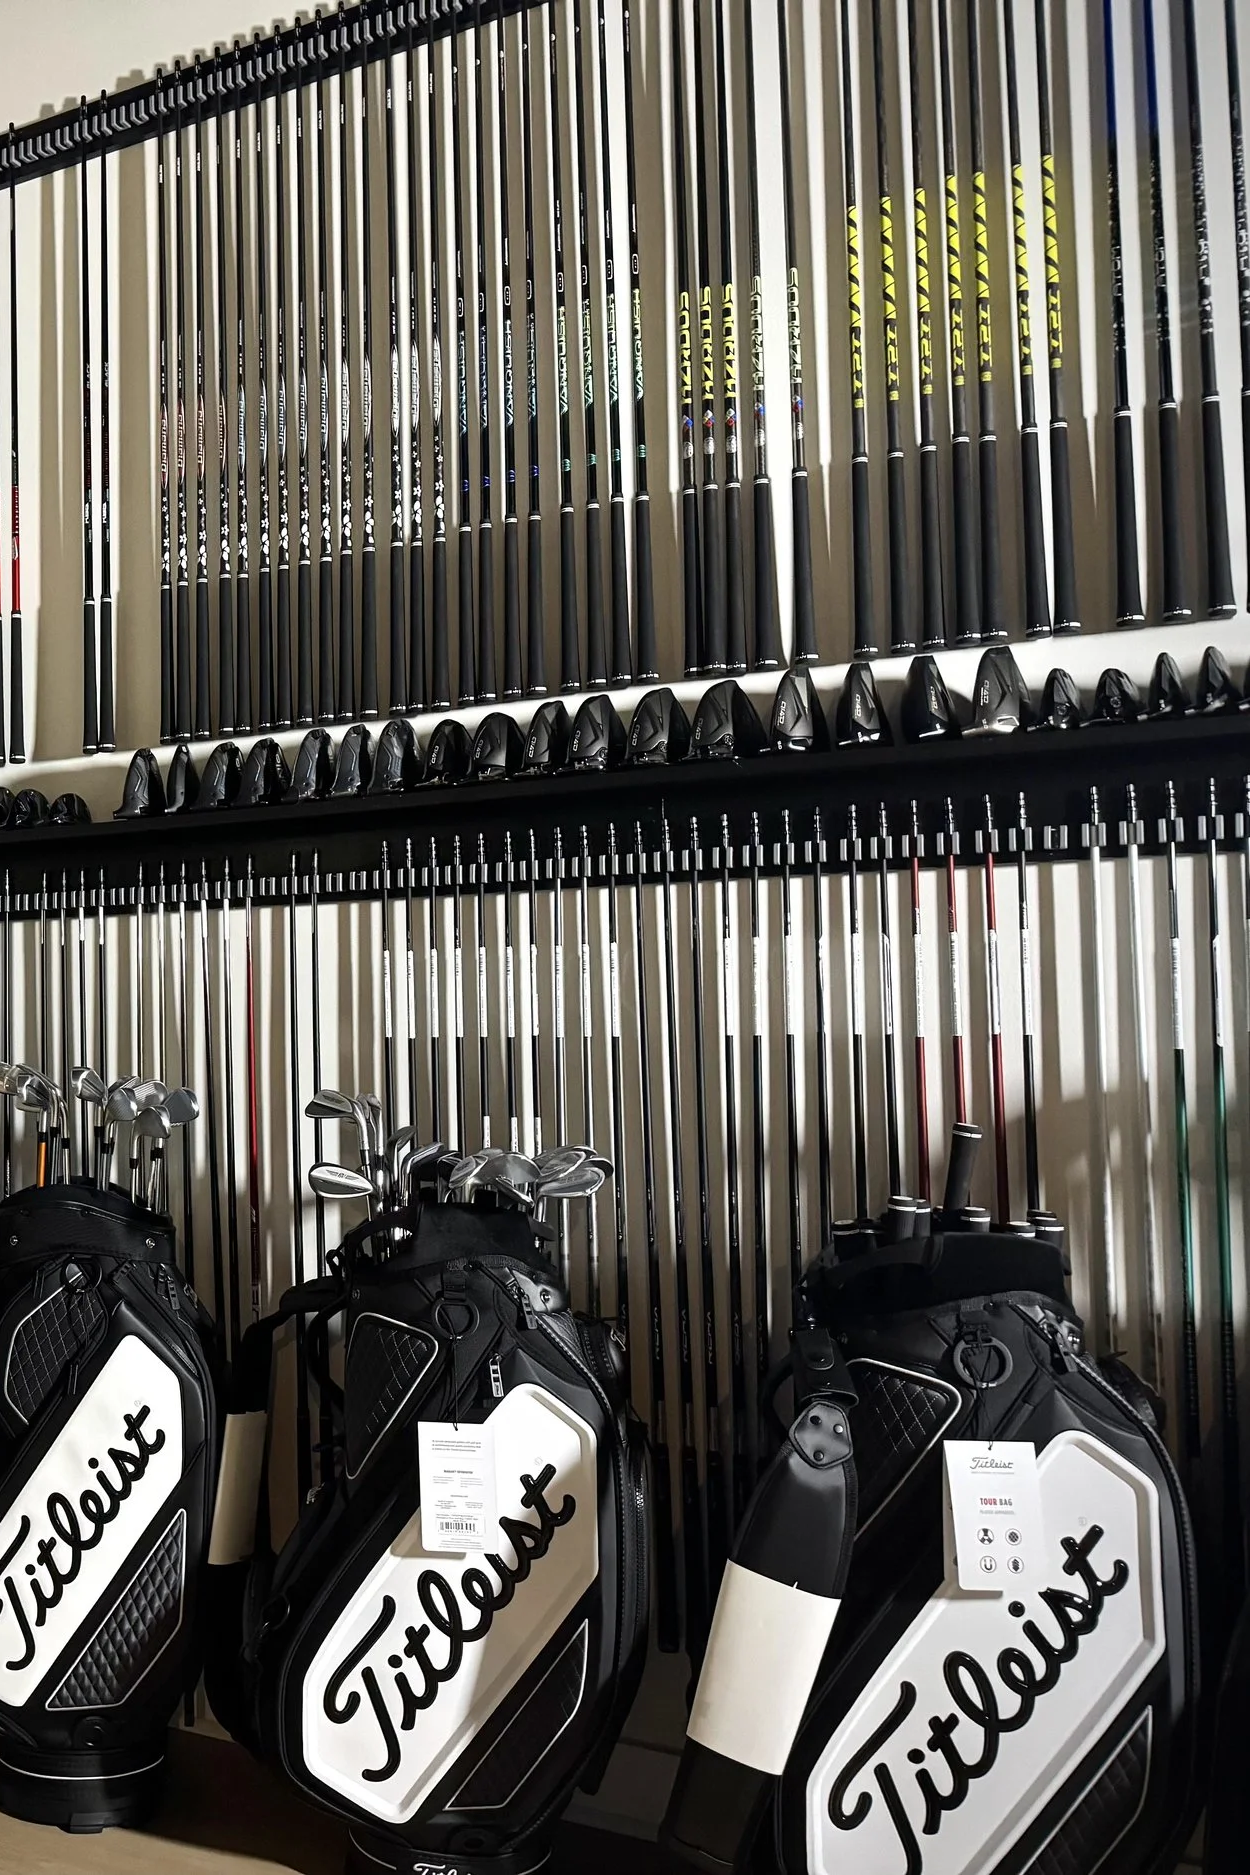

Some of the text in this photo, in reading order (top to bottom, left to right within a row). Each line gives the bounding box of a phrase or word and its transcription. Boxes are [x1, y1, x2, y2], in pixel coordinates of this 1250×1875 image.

[504, 319, 514, 426] VANQUISH
[557, 305, 569, 414] VANQUISH
[607, 292, 618, 405] VANQUISH
[632, 288, 644, 400] VANQUISH
[969, 1457, 1015, 1470] Titleist
[980, 1498, 997, 1506] TOUR
[323, 1463, 577, 1783] Titleist
[827, 1523, 1129, 1875] Titleist
